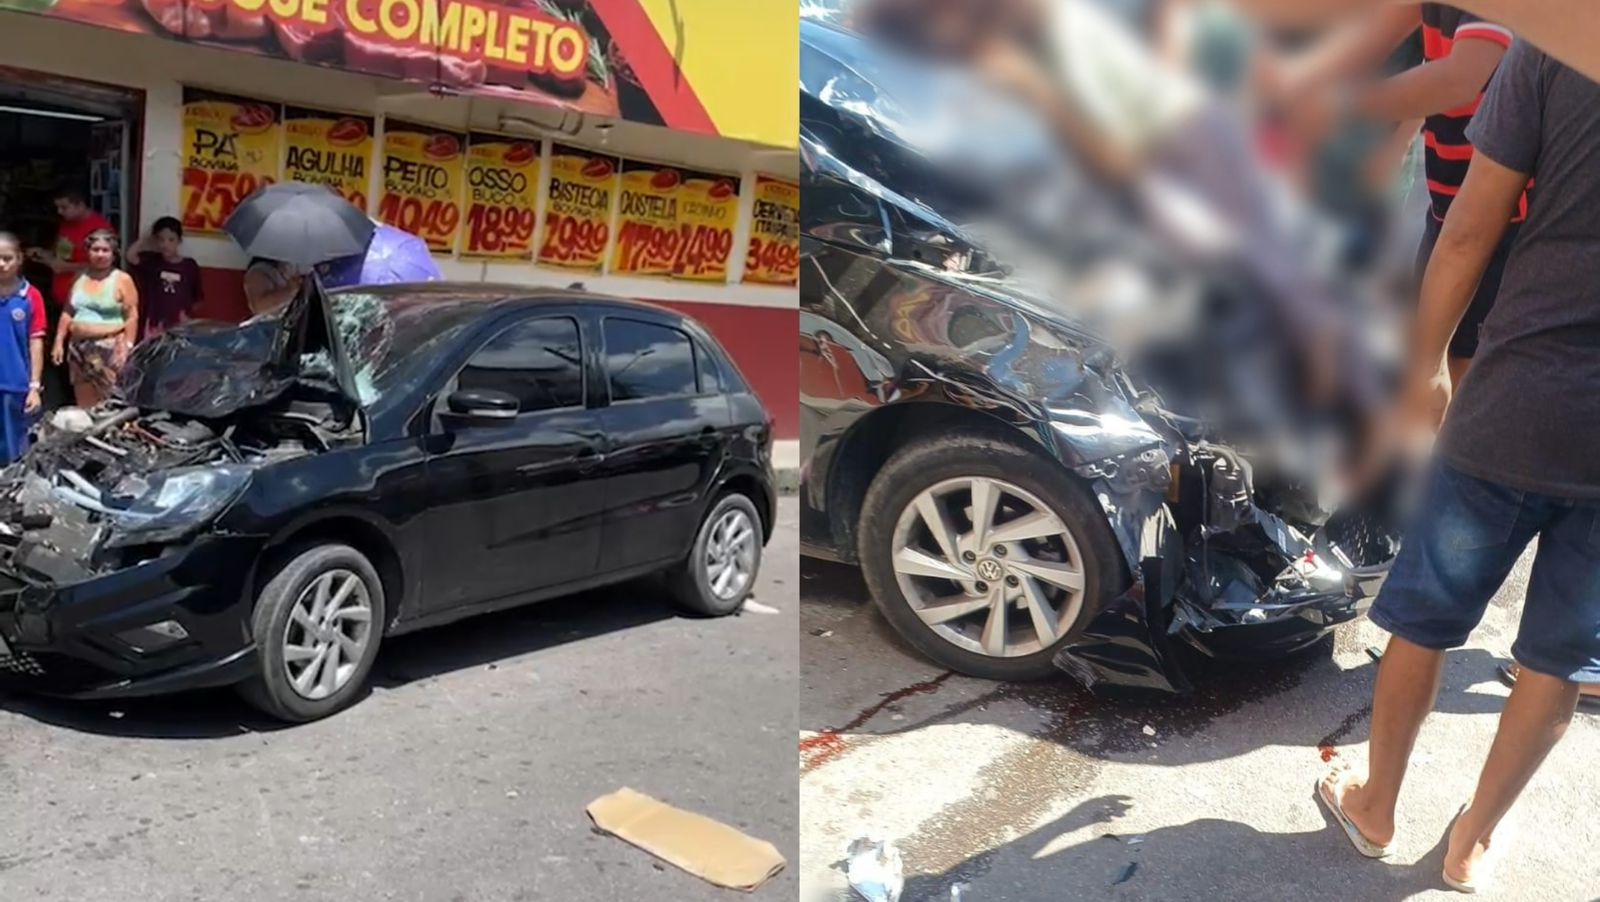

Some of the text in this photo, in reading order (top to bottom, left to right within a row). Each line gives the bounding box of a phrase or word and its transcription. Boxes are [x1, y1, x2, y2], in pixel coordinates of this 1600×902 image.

[347, 0, 584, 72] COMPLETO
[286, 146, 365, 179] AGULHA
[383, 155, 449, 189] PEITO
[469, 166, 527, 193] OSSO
[549, 178, 608, 211] BISTECA
[620, 190, 677, 221] COSTELA
